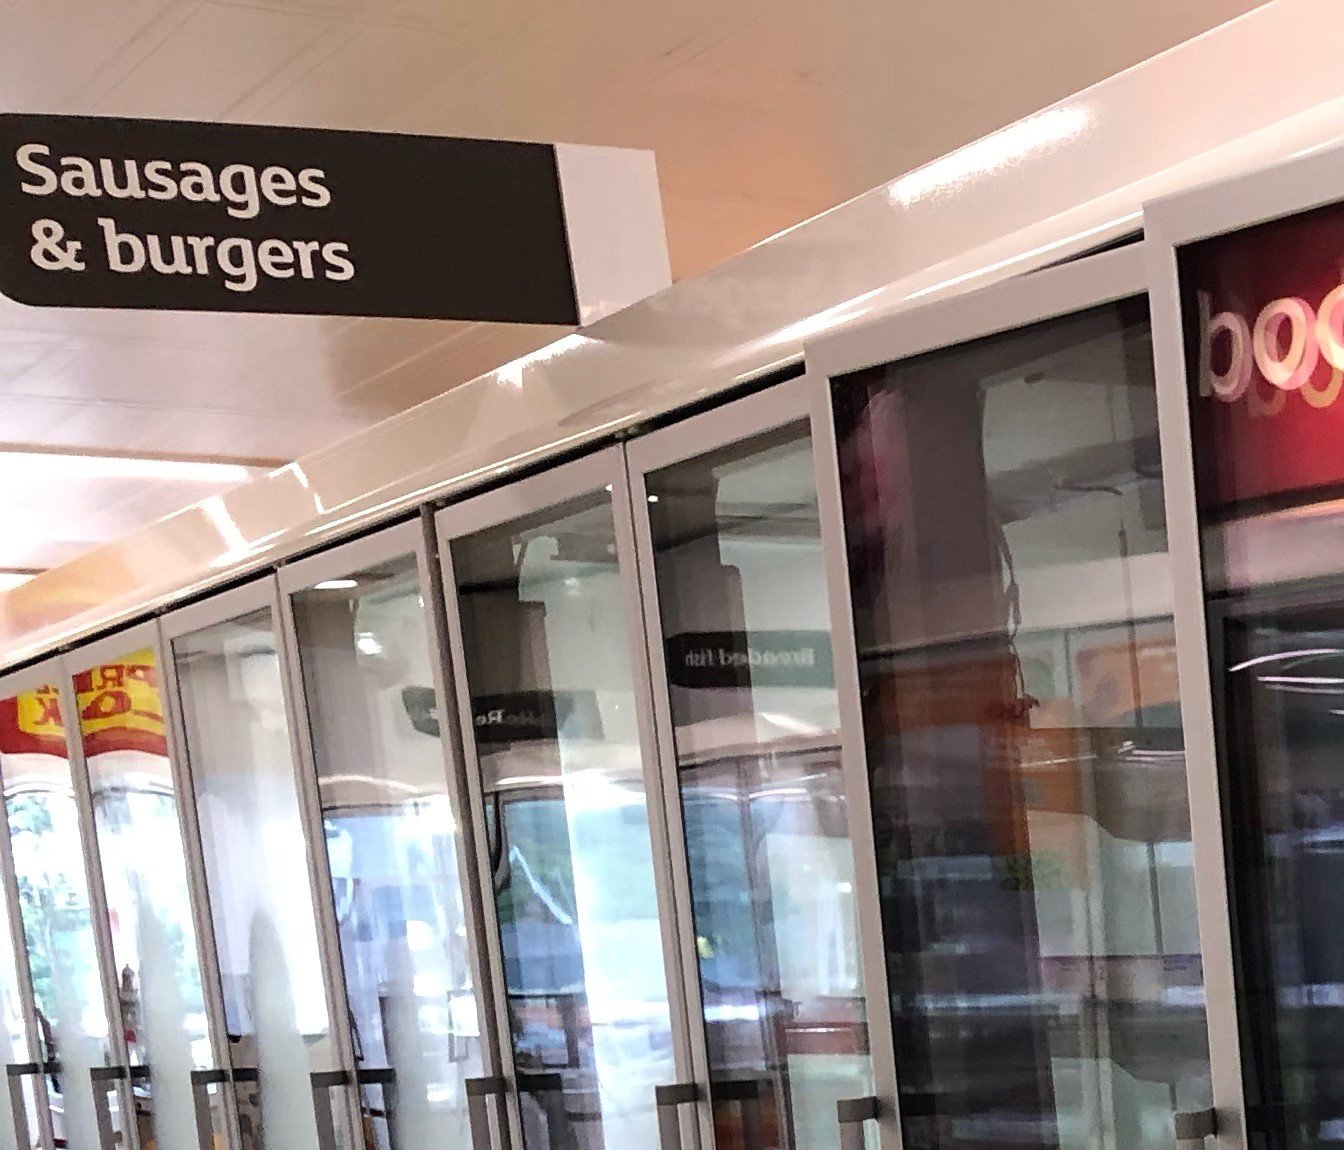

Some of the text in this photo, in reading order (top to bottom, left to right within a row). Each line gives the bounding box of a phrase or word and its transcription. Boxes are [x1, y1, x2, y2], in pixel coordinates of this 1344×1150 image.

[14, 143, 331, 219] Sausages
[30, 217, 355, 294] & burgers
